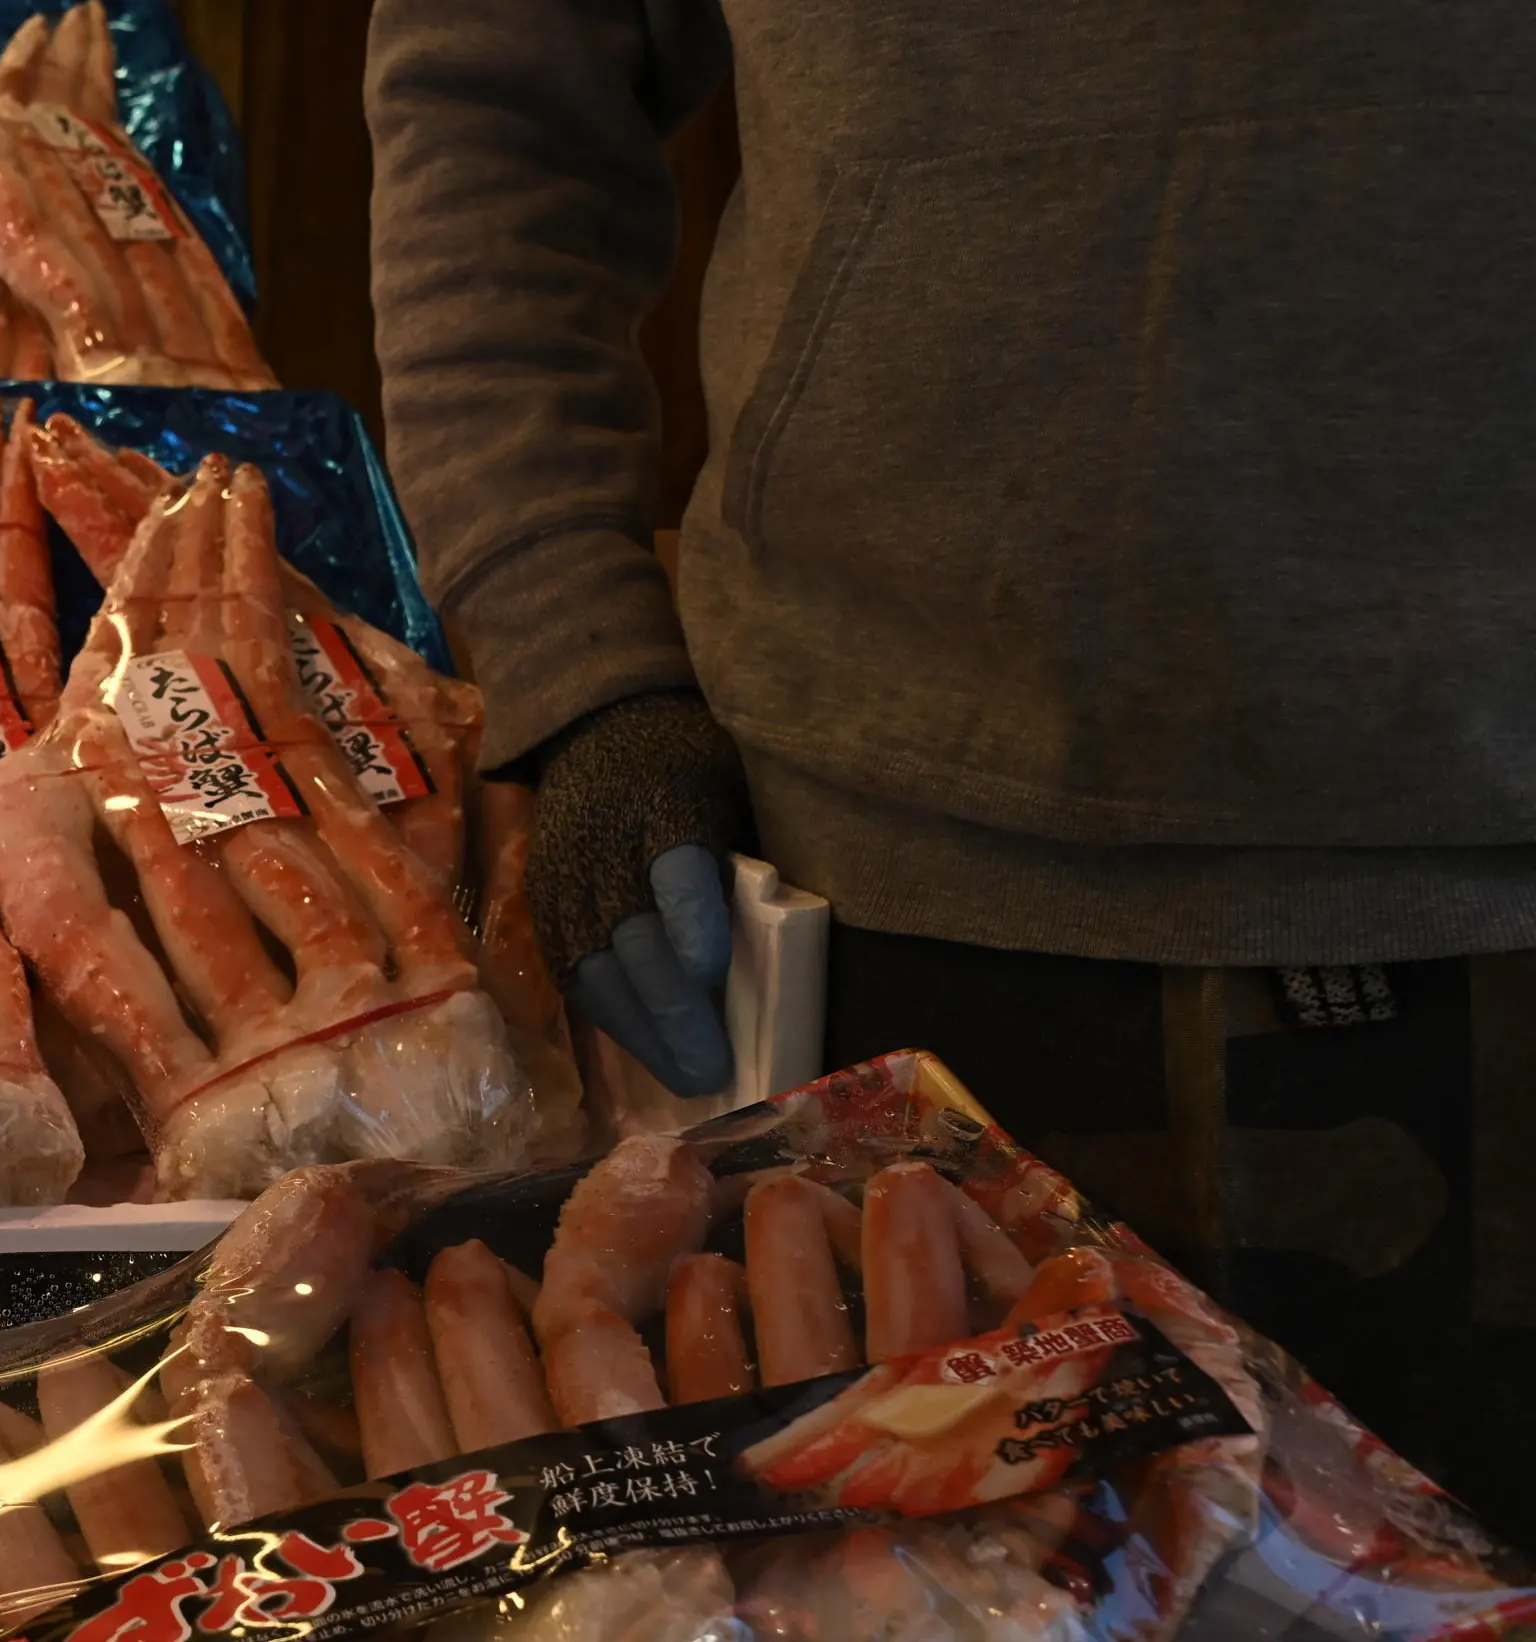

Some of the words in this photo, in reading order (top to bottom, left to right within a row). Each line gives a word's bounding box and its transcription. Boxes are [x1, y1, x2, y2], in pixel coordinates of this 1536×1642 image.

[150, 666, 265, 809] たらば蟹
[539, 1430, 721, 1490] 船上凍結で
